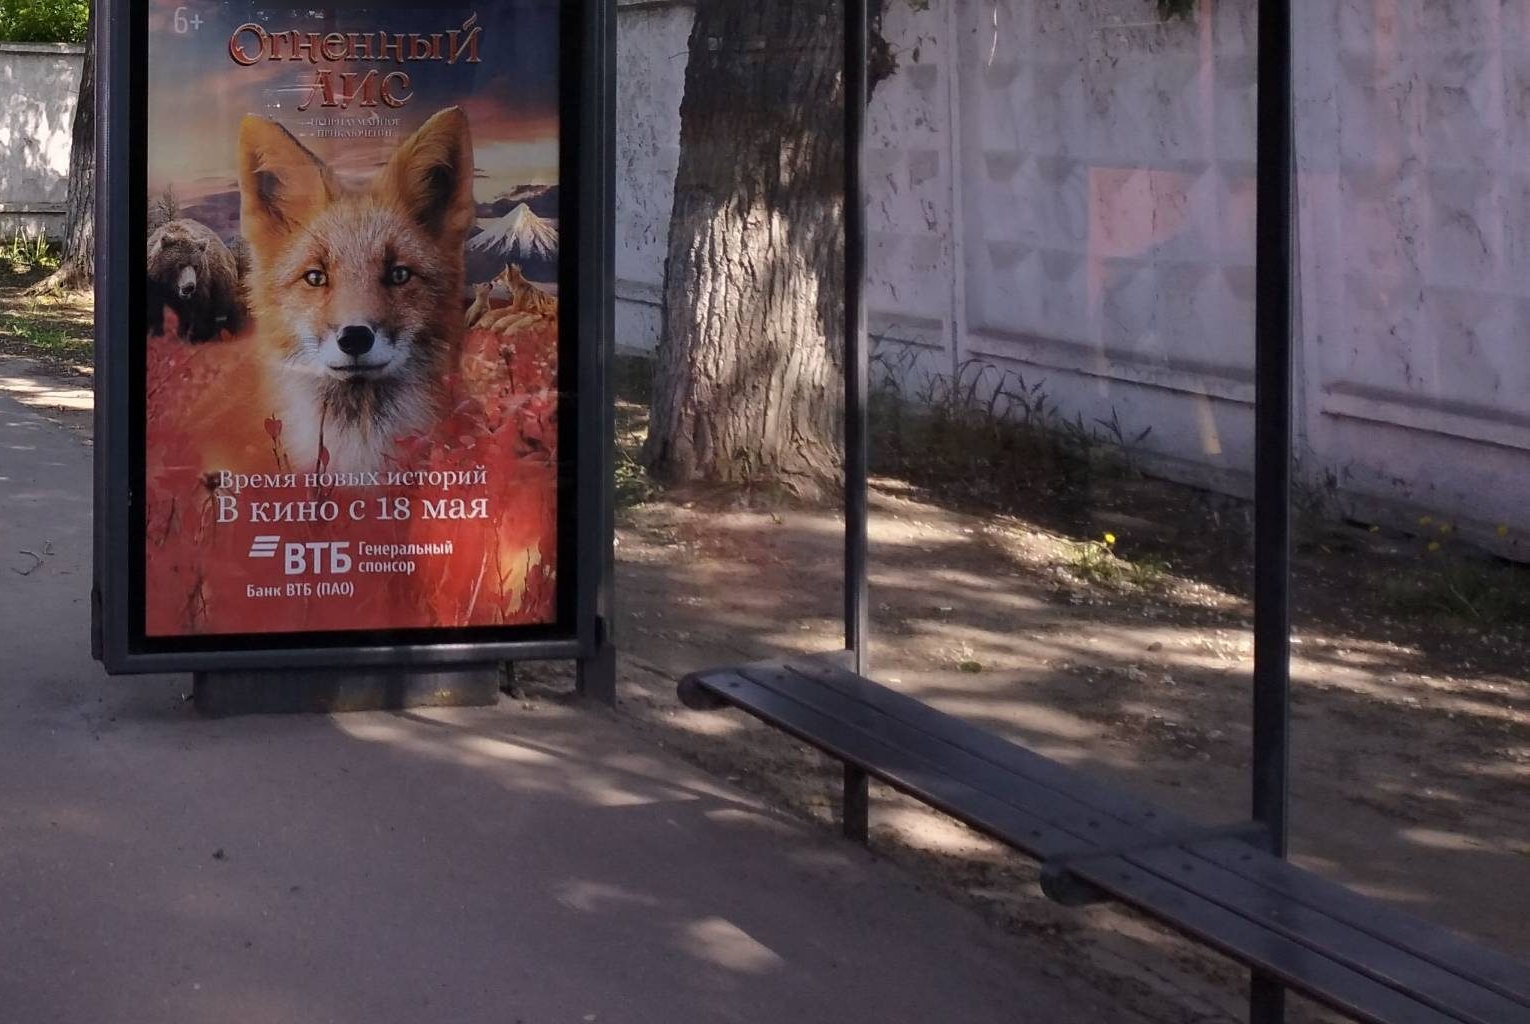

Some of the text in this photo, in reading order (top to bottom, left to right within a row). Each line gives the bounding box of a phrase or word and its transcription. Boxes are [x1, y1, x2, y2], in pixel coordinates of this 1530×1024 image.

[173, 6, 203, 34] 6+
[317, 128, 398, 137] ПРИКЛЮЧЕНИ
[219, 464, 487, 493] Время новых историй
[217, 495, 489, 523] В кино с 18 мая
[284, 541, 352, 575] ВТБ
[358, 540, 453, 558] Генеральный
[358, 559, 415, 576] спонсор
[246, 581, 354, 598] Банк ВТБ (ПАО)
